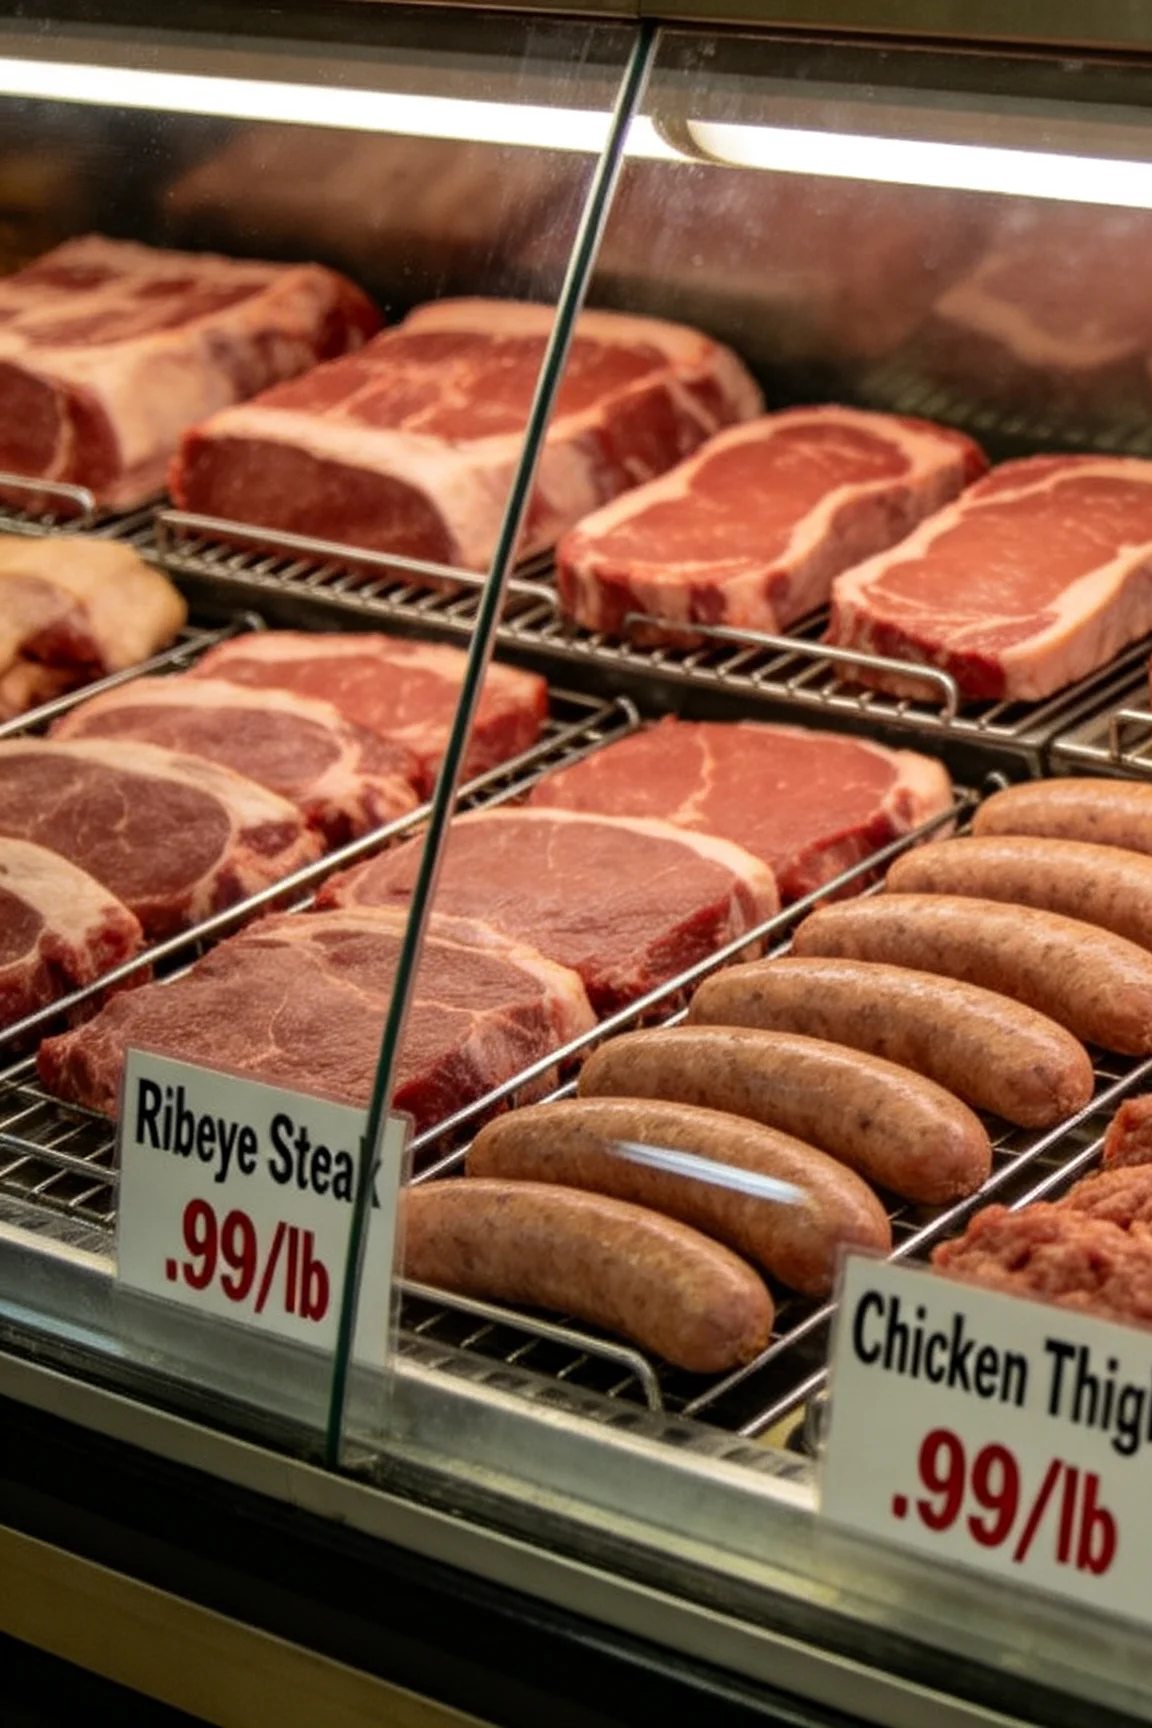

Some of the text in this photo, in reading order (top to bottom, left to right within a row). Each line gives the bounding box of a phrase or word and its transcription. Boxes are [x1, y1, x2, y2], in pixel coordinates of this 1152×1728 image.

[136, 1077, 258, 1184] Ribeye
[165, 1198, 330, 1323] .99/lb
[852, 1290, 1029, 1408] Chicken
[891, 1427, 1118, 1577] .99/lb
